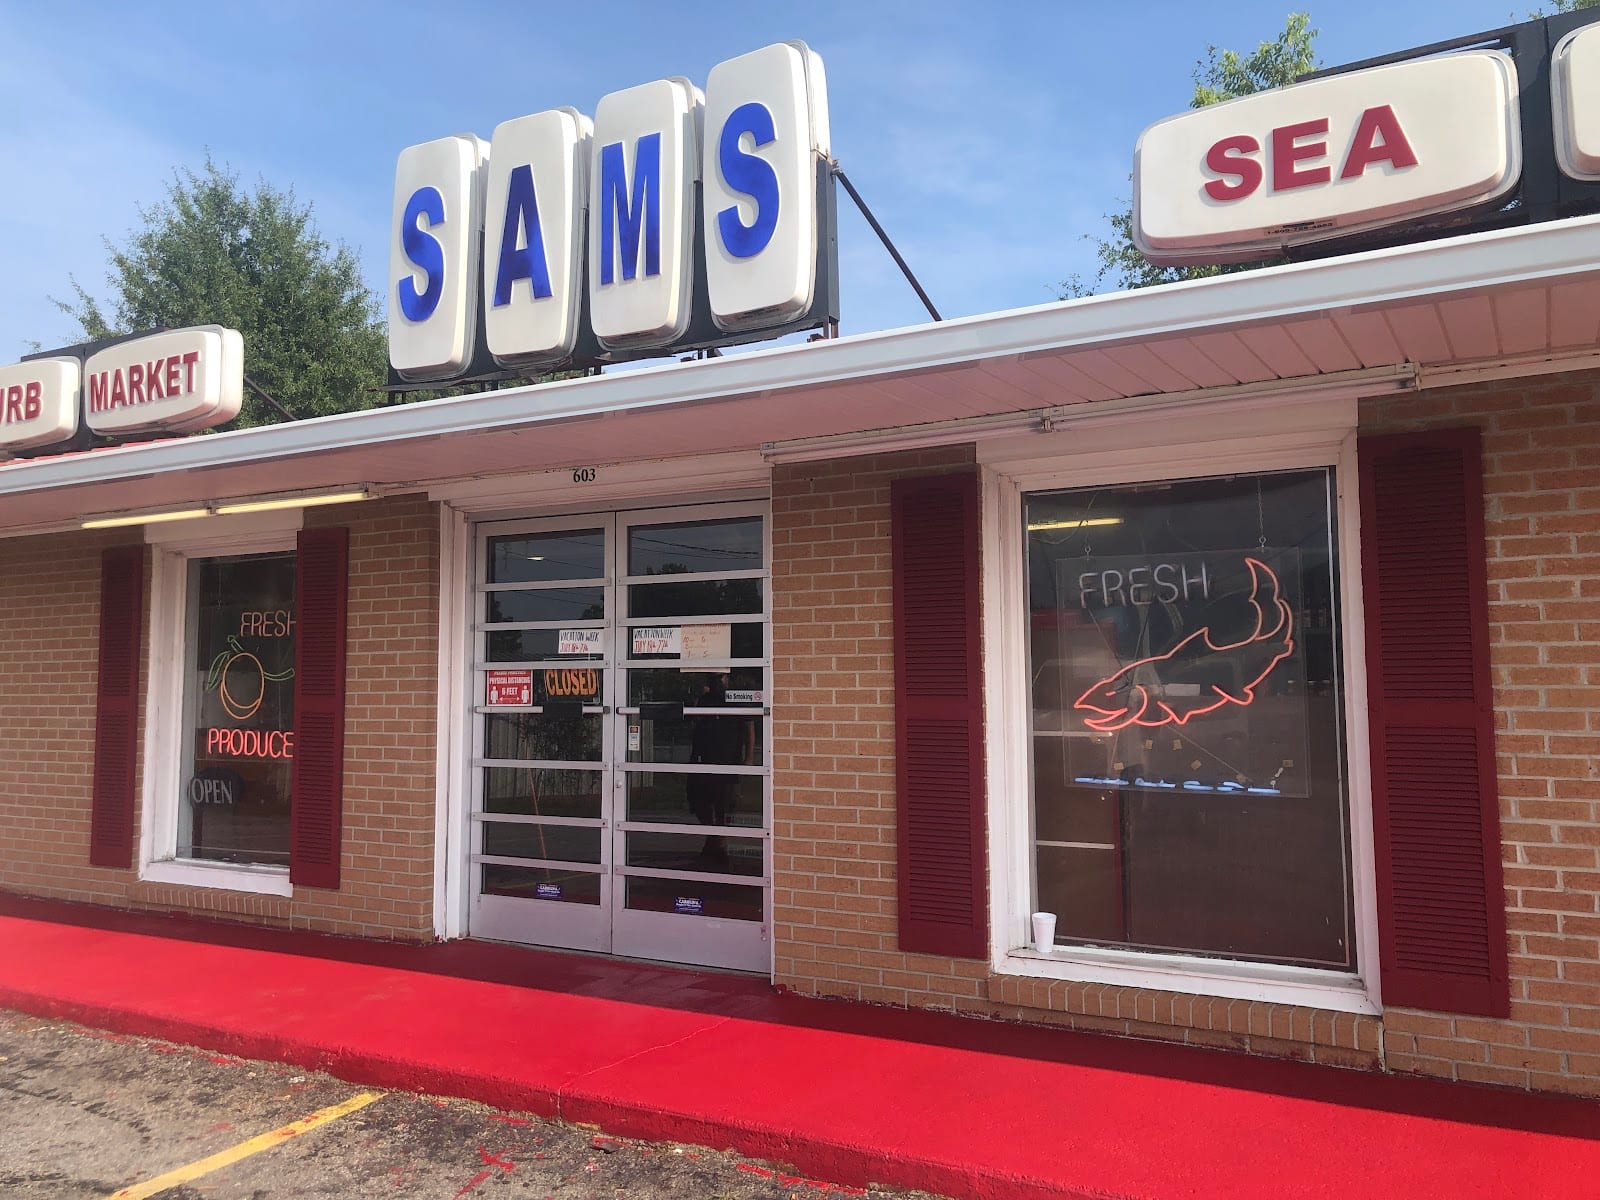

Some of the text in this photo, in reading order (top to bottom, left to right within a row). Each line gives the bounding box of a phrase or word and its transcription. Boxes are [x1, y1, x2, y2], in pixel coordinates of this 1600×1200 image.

[1204, 104, 1419, 201] SEA
[399, 102, 780, 322] SAMS
[0, 351, 199, 424] RB MARKET
[573, 468, 596, 483] 603
[1079, 560, 1209, 608] FRESH
[506, 687, 518, 696] FEET
[546, 668, 597, 696] CLOSED
[726, 690, 753, 701] No Smoking
[207, 728, 295, 758] PRODUCE
[191, 778, 233, 804] OPEN
